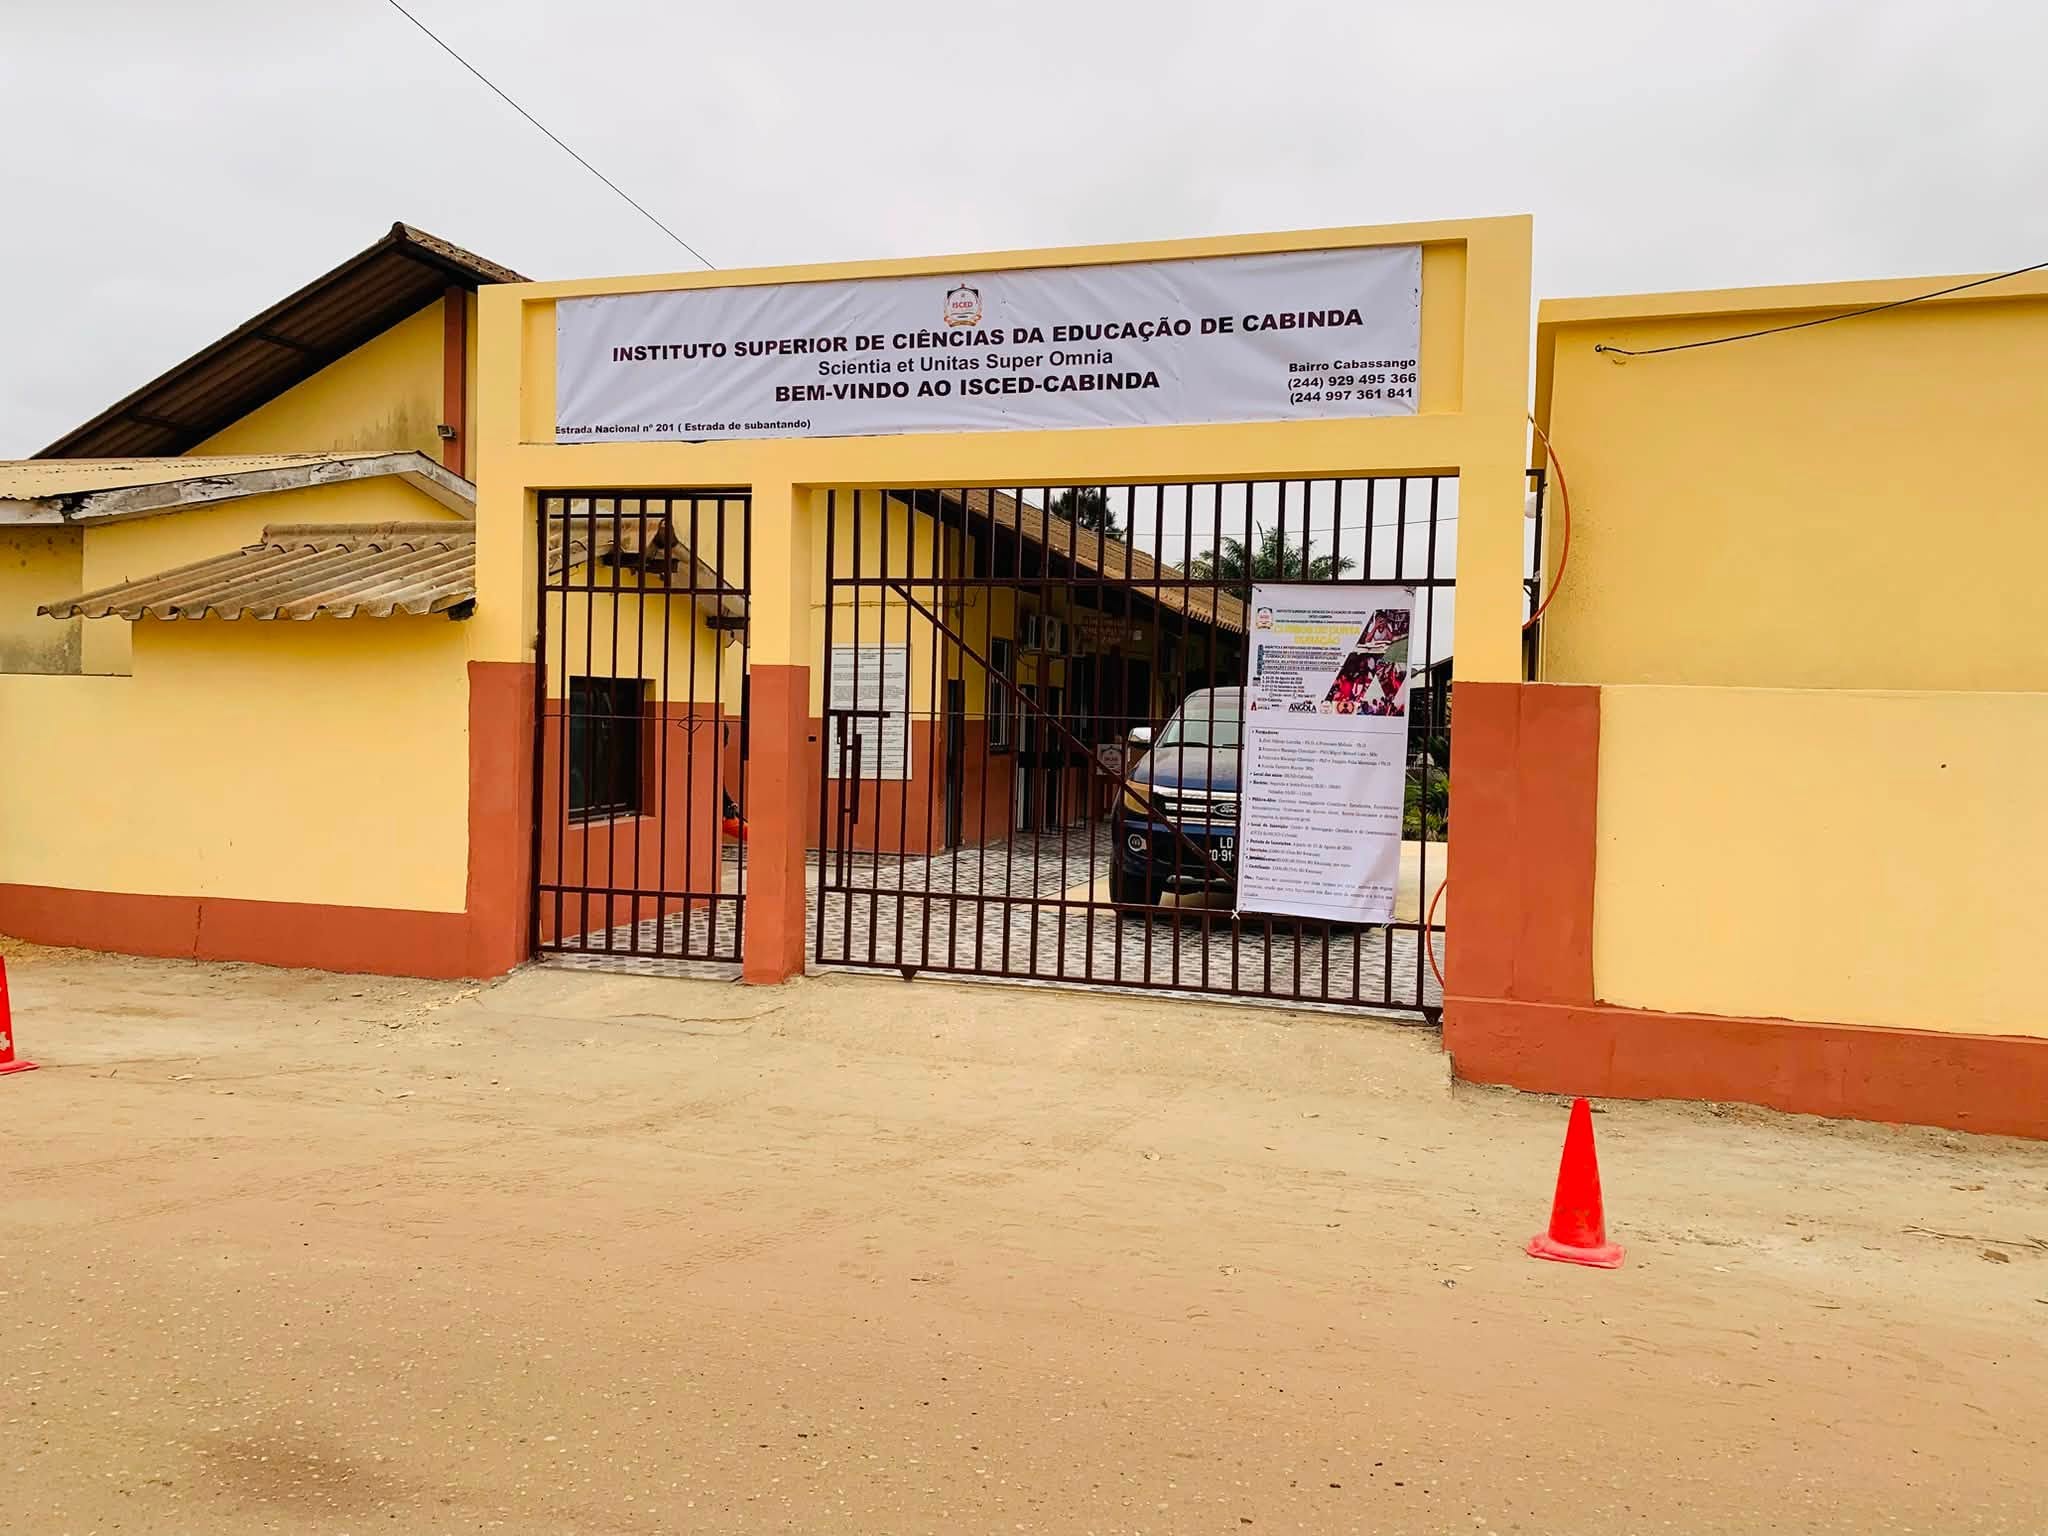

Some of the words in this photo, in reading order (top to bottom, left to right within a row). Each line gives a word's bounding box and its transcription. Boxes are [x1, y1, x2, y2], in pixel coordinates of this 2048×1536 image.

[952, 301, 973, 309] ISCED
[612, 342, 727, 362] INSTITUTO
[734, 336, 848, 357] SUPERIOR
[855, 335, 885, 351] DE
[892, 328, 1004, 350] CIÊNCIAS
[1012, 327, 1044, 344] DA
[1052, 317, 1191, 342] EDUCAÇÃO
[1200, 316, 1234, 334] DE
[1242, 309, 1363, 332] CABINDA
[818, 358, 891, 376] Scientia
[896, 358, 914, 373] et
[921, 355, 980, 372] Unitas
[986, 353, 1043, 372] Super
[1049, 350, 1113, 367] Omnia
[1289, 362, 1329, 372] Bairro
[1334, 359, 1416, 370] Cabassango
[775, 382, 910, 402] BEM-VINDO
[917, 379, 951, 397] AO
[960, 371, 1160, 396] ISCED-CABINDA
[1288, 377, 1324, 390] (244)
[1328, 375, 1354, 386] 929
[1358, 374, 1385, 385] 495
[1390, 373, 1417, 384] 366
[1290, 391, 1321, 405] (244
[1325, 390, 1352, 401] 997
[1356, 389, 1382, 400] 361
[1387, 387, 1413, 398] 841
[555, 426, 592, 435] Estrada
[595, 424, 640, 433] Nacional
[656, 423, 675, 433] 201
[685, 422, 726, 432] Estrada
[728, 421, 741, 431] de
[744, 419, 811, 431] subantando)
